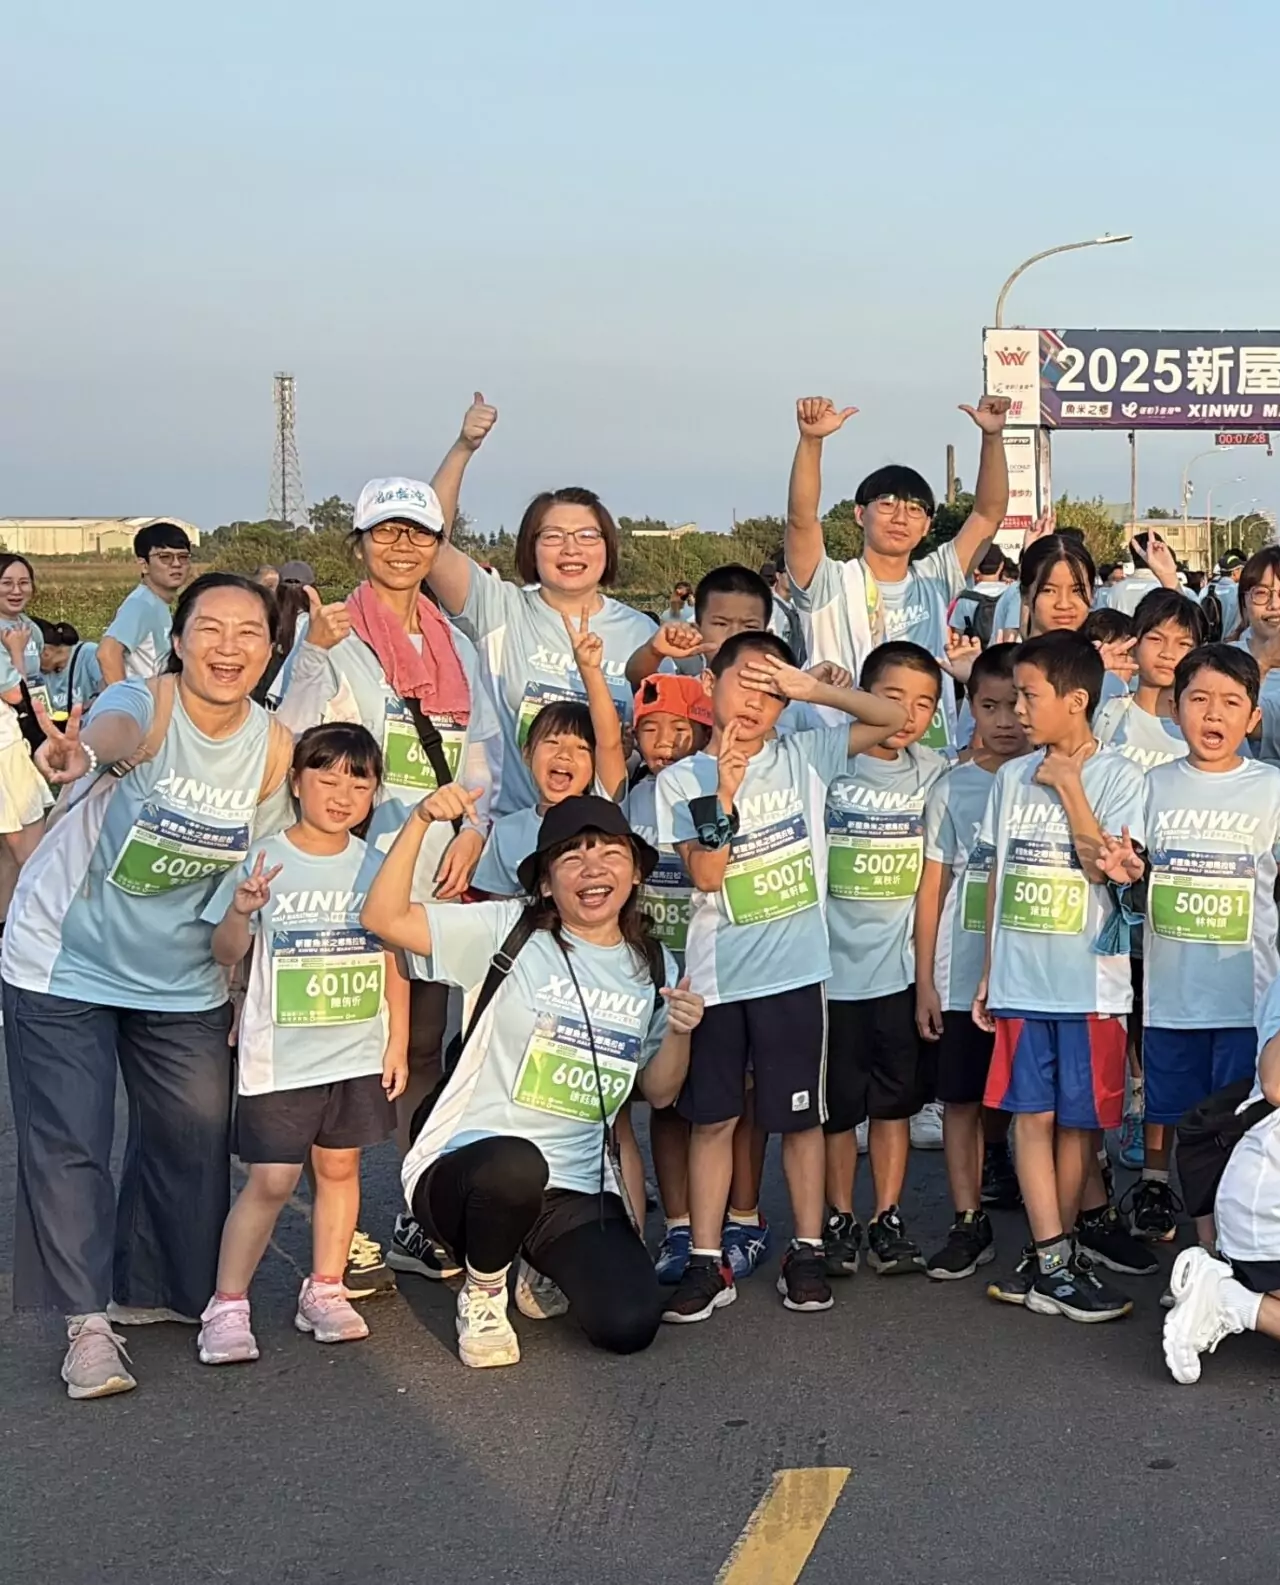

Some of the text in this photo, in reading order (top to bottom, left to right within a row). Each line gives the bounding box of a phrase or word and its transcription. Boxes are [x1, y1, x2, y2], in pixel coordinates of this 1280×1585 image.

[1187, 404, 1254, 418] XINWU
[1218, 433, 1266, 444] 00:07:28
[155, 768, 258, 810] XINWU
[1155, 809, 1261, 834] XINWU
[753, 855, 814, 896] 50079
[853, 853, 918, 874] 50074
[272, 891, 367, 916] XINW
[1014, 881, 1082, 907] 50078
[1174, 892, 1244, 917] 50081
[306, 970, 380, 998] 60104
[536, 974, 649, 1018] XINWU
[552, 1063, 627, 1099] 60089
